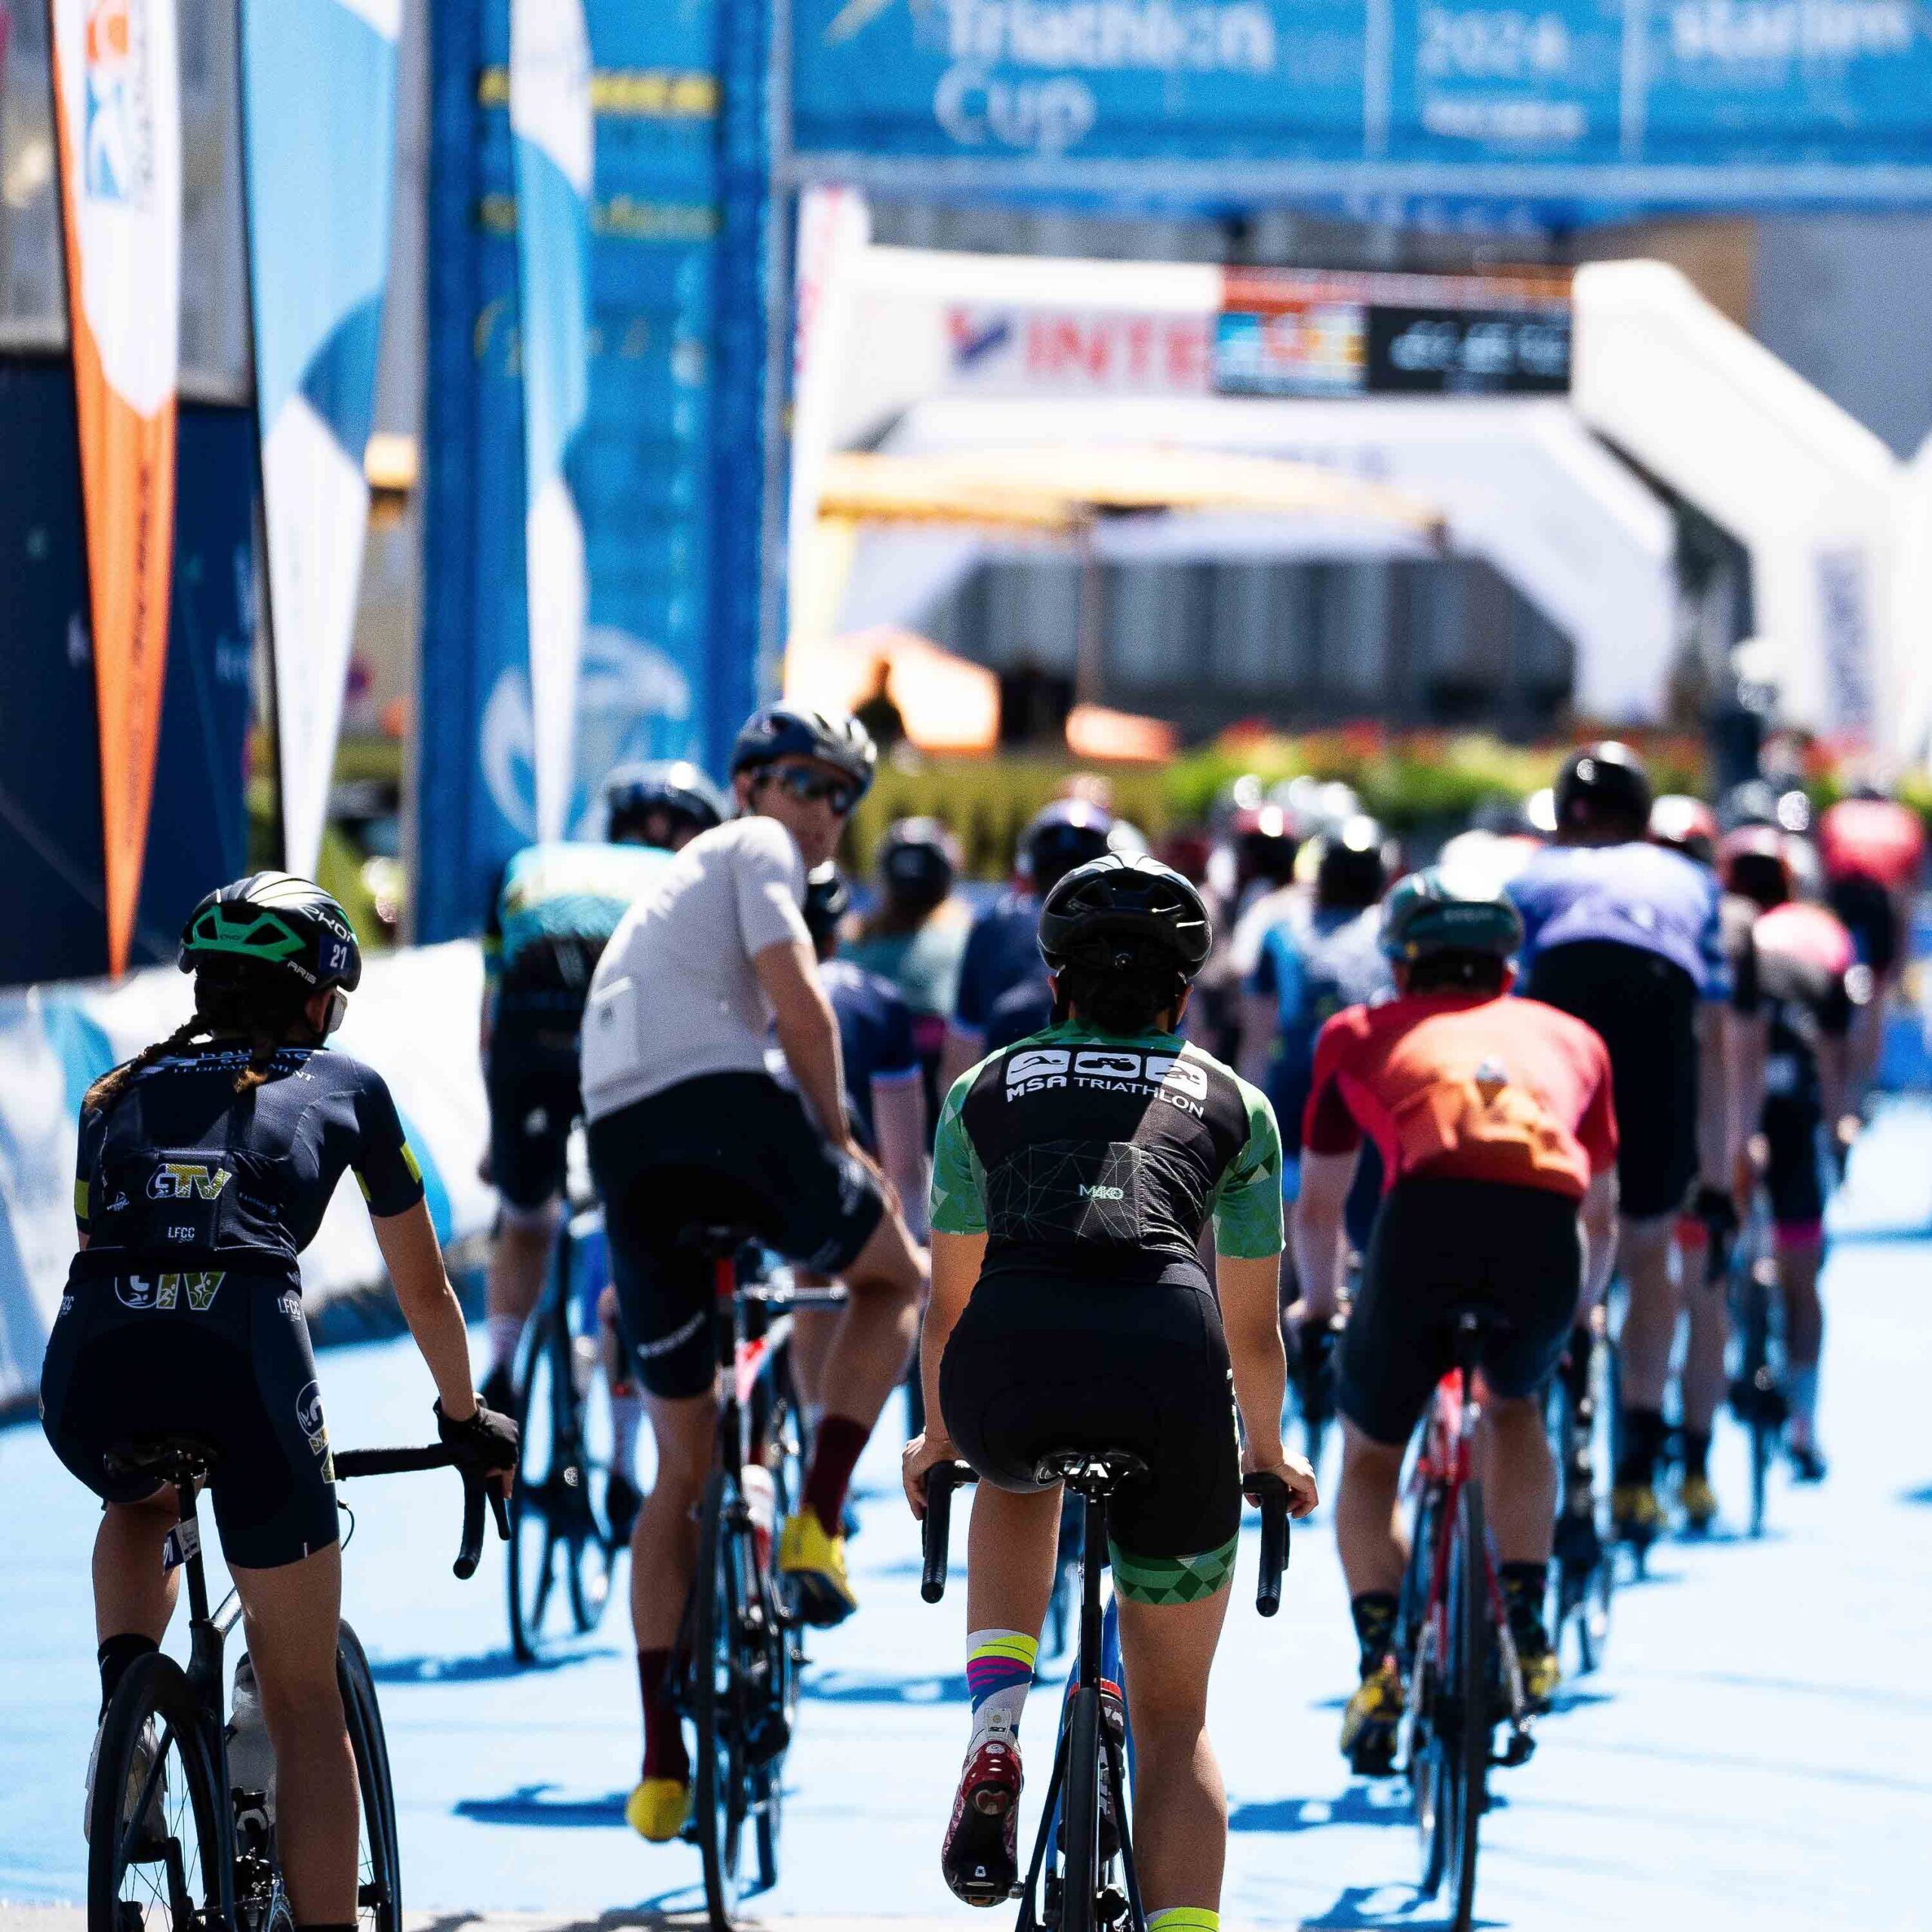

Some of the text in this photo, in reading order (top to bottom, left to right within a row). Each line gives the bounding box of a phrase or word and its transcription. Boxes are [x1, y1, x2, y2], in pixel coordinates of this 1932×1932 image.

[934, 64, 1097, 155] Cup
[330, 943, 347, 970] 21
[1006, 1075, 1204, 1118] MSA TRIATHLON
[168, 1226, 195, 1238] LFCC
[277, 1297, 301, 1316] LFCC
